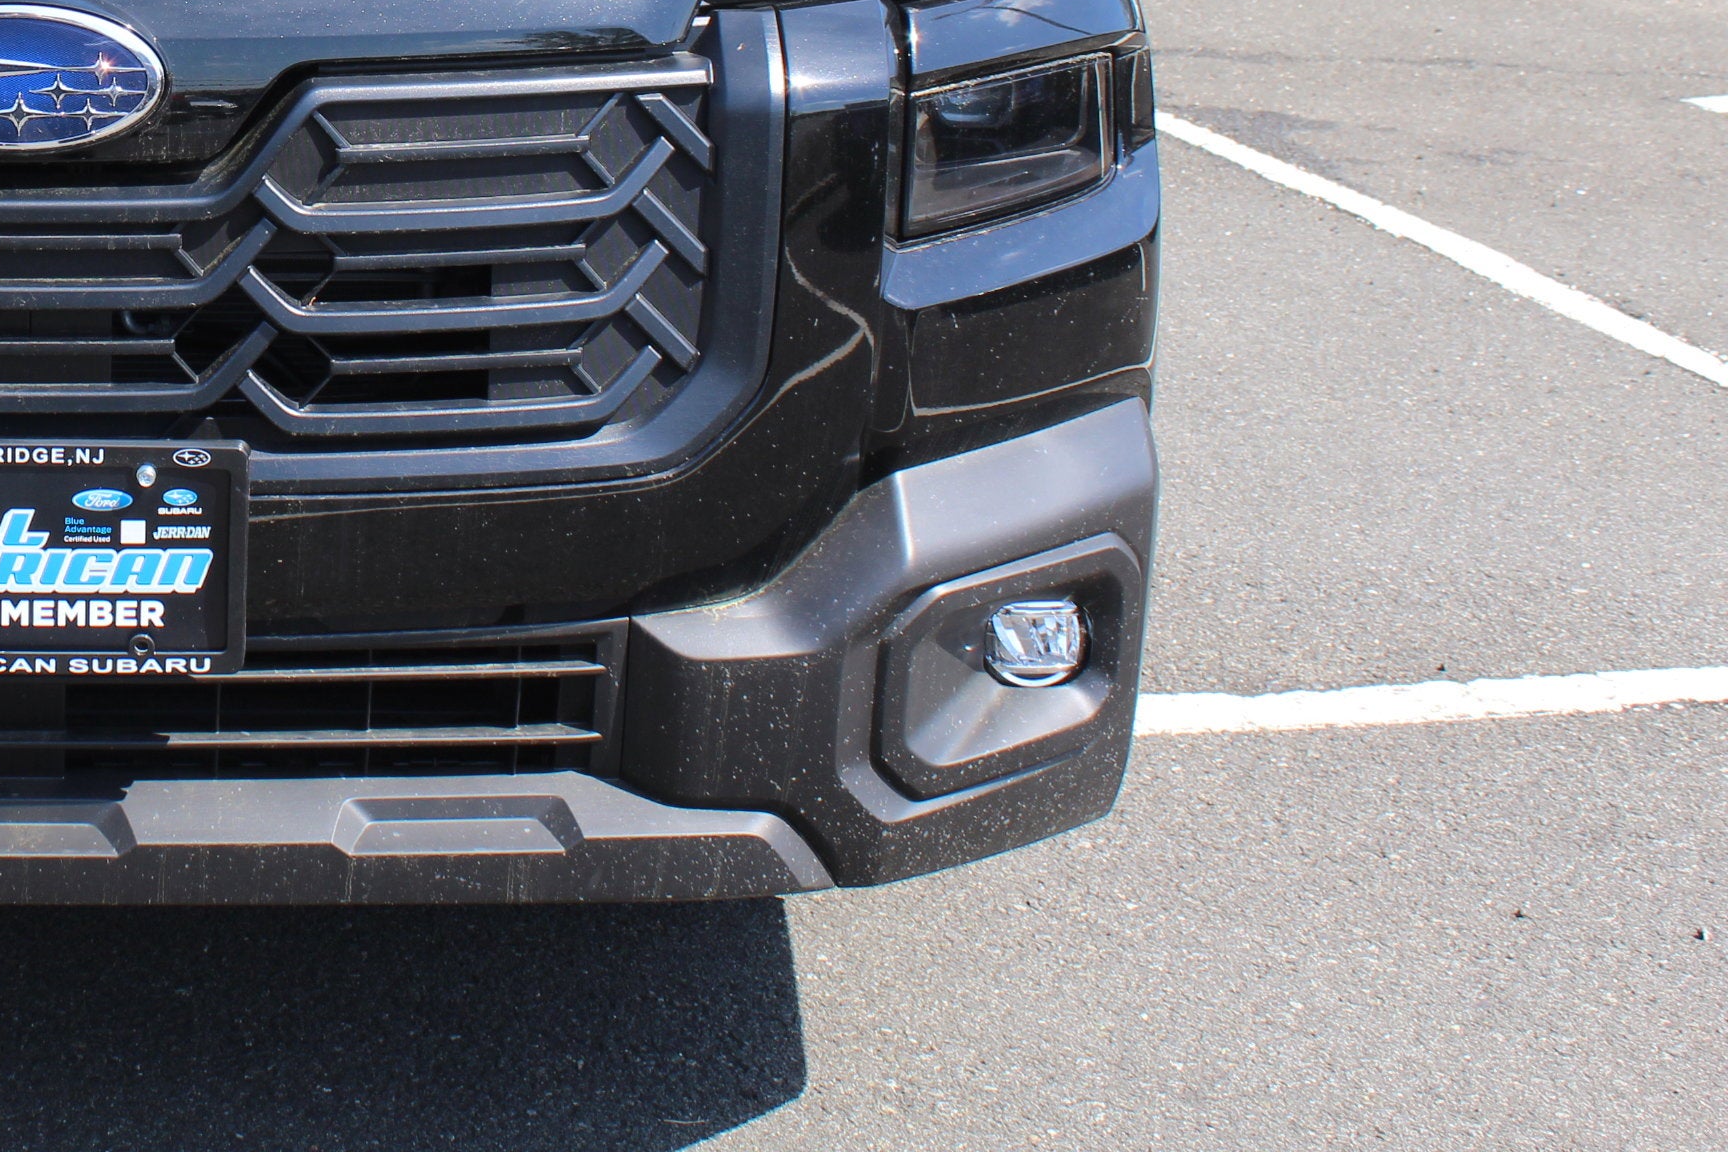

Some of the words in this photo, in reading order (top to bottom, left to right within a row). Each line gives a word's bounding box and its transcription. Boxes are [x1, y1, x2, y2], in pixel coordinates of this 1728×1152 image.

[84, 493, 121, 508] Ford
[65, 517, 85, 525] Blue
[65, 526, 112, 535] Advantage
[93, 535, 111, 543] Used
[1, 599, 165, 628] MEMBER
[68, 657, 211, 674] SUBARU
